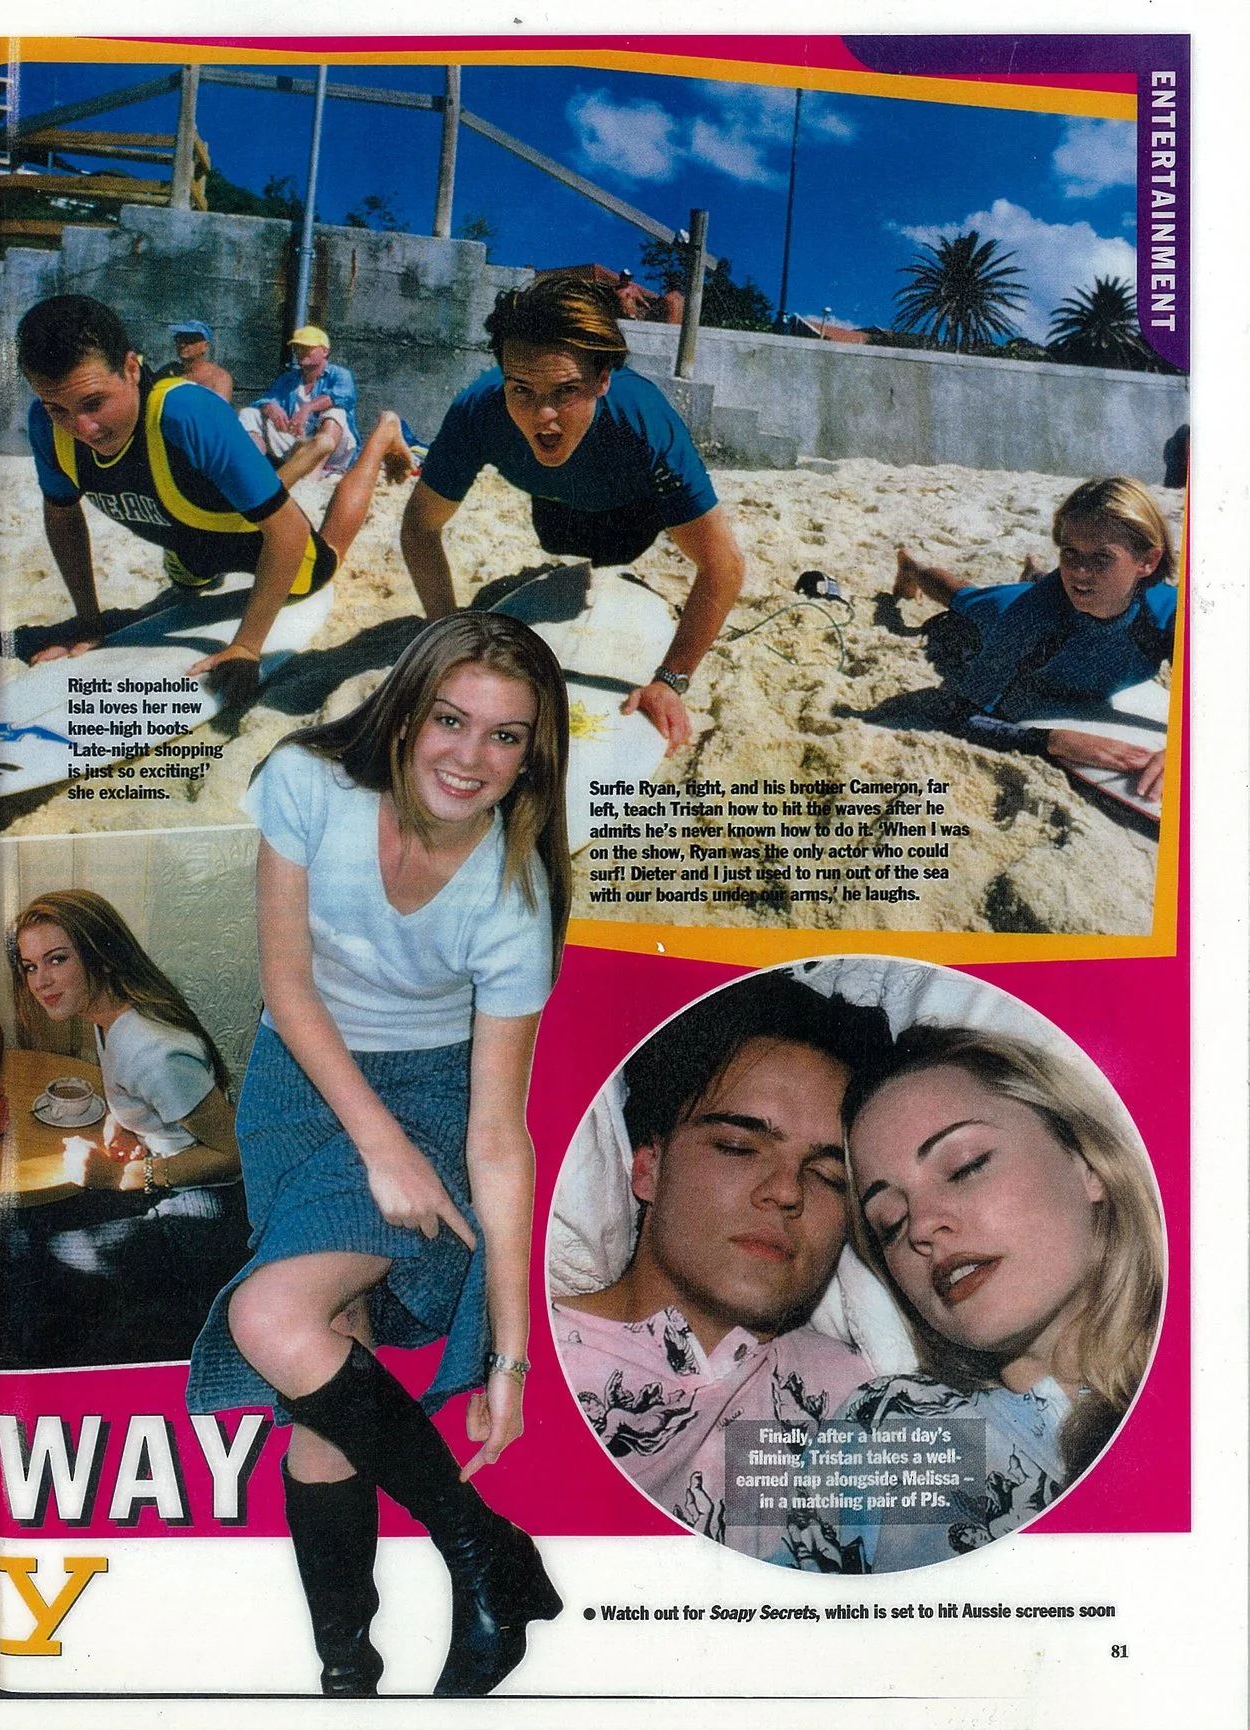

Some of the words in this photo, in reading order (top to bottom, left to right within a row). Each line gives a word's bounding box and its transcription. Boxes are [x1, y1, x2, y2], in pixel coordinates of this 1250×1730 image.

[1151, 71, 1176, 332] ENTERTAINMENT
[68, 678, 112, 695] Right:
[117, 678, 198, 695] shopaholic
[68, 700, 94, 714] Isla
[100, 700, 137, 714] loves
[143, 700, 167, 713] her
[172, 703, 202, 713] new
[68, 721, 142, 738] knee-high
[147, 721, 193, 735] boots.
[68, 742, 150, 759] ‘Late-night
[155, 742, 223, 759] shopping
[68, 764, 80, 778] is
[84, 764, 113, 780] just
[118, 768, 135, 778] so
[140, 763, 210, 780] exciting!’
[68, 785, 94, 799] she
[99, 785, 169, 799] exclaims.
[590, 781, 634, 795] Surfie
[639, 781, 680, 797] Ryan,
[686, 780, 725, 797] right,
[731, 780, 758, 794] and
[764, 780, 785, 794] his
[790, 780, 846, 794] brother
[850, 779, 923, 796] Cameron,
[927, 779, 949, 793] far
[590, 802, 618, 819] left,
[623, 802, 665, 816] teach
[670, 802, 723, 816] Tristan
[728, 801, 758, 816] how
[762, 802, 777, 815] to
[783, 801, 802, 815] hit
[806, 801, 831, 815] the
[836, 804, 881, 815] waves
[886, 800, 922, 815] after
[926, 800, 944, 814] he
[760, 1429, 813, 1446] Finally,
[817, 1429, 854, 1443] after
[858, 1431, 867, 1442] a
[872, 1427, 906, 1442] hard
[911, 1427, 951, 1445] day’s
[601, 1605, 649, 1621] Watch
[654, 1606, 679, 1620] out
[683, 1605, 705, 1620] for
[709, 1604, 756, 1623] Soapy
[759, 1604, 820, 1622] Secrets,
[826, 1604, 869, 1620] which
[874, 1604, 887, 1619] is
[891, 1605, 914, 1618] set
[918, 1605, 934, 1618] to
[938, 1603, 958, 1618] hit
[962, 1603, 1012, 1618] Aussie
[1015, 1605, 1075, 1618] screens
[1079, 1605, 1116, 1617] soon
[1111, 1644, 1129, 1658] 81
